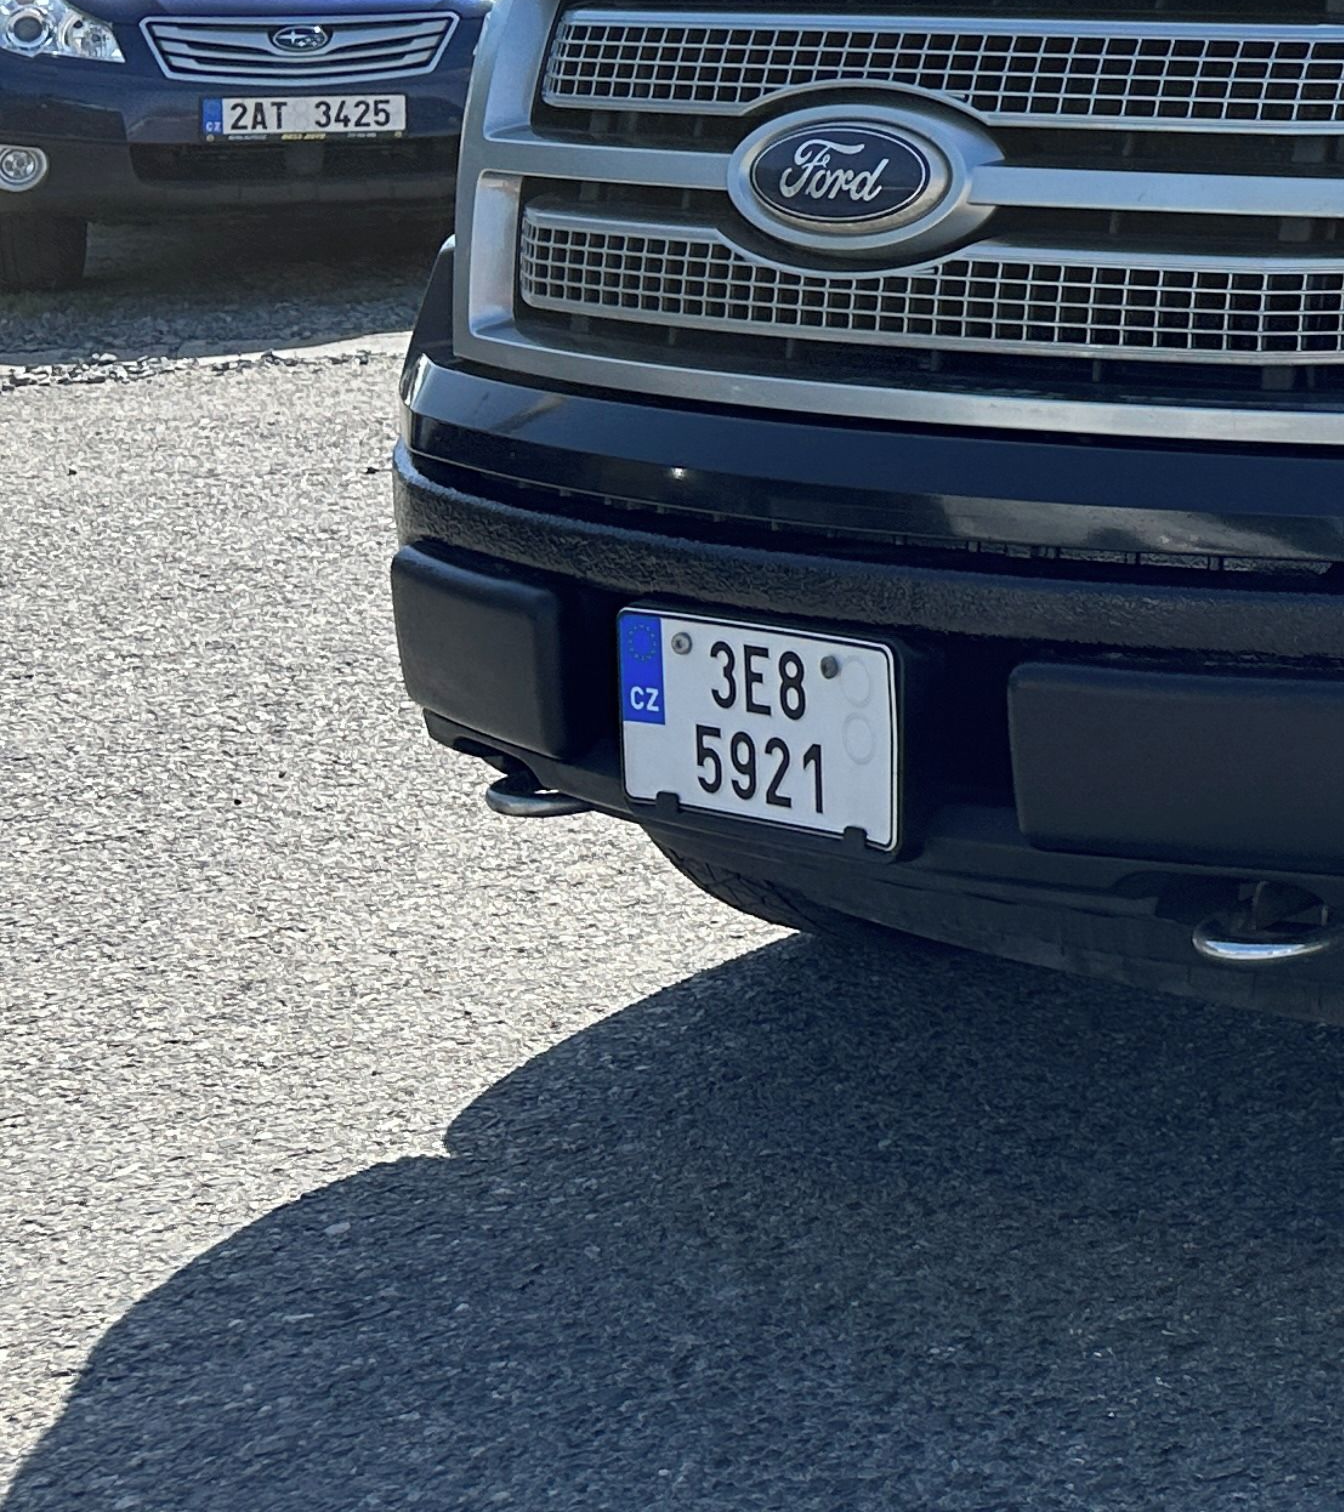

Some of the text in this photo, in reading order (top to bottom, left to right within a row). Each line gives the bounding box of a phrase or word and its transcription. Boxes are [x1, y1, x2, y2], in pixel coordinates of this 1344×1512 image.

[230, 99, 391, 130] 2AT 3425
[780, 139, 889, 202] Ford
[630, 686, 660, 713] CZ
[709, 641, 806, 721] 3E8
[695, 723, 824, 814] 5921
